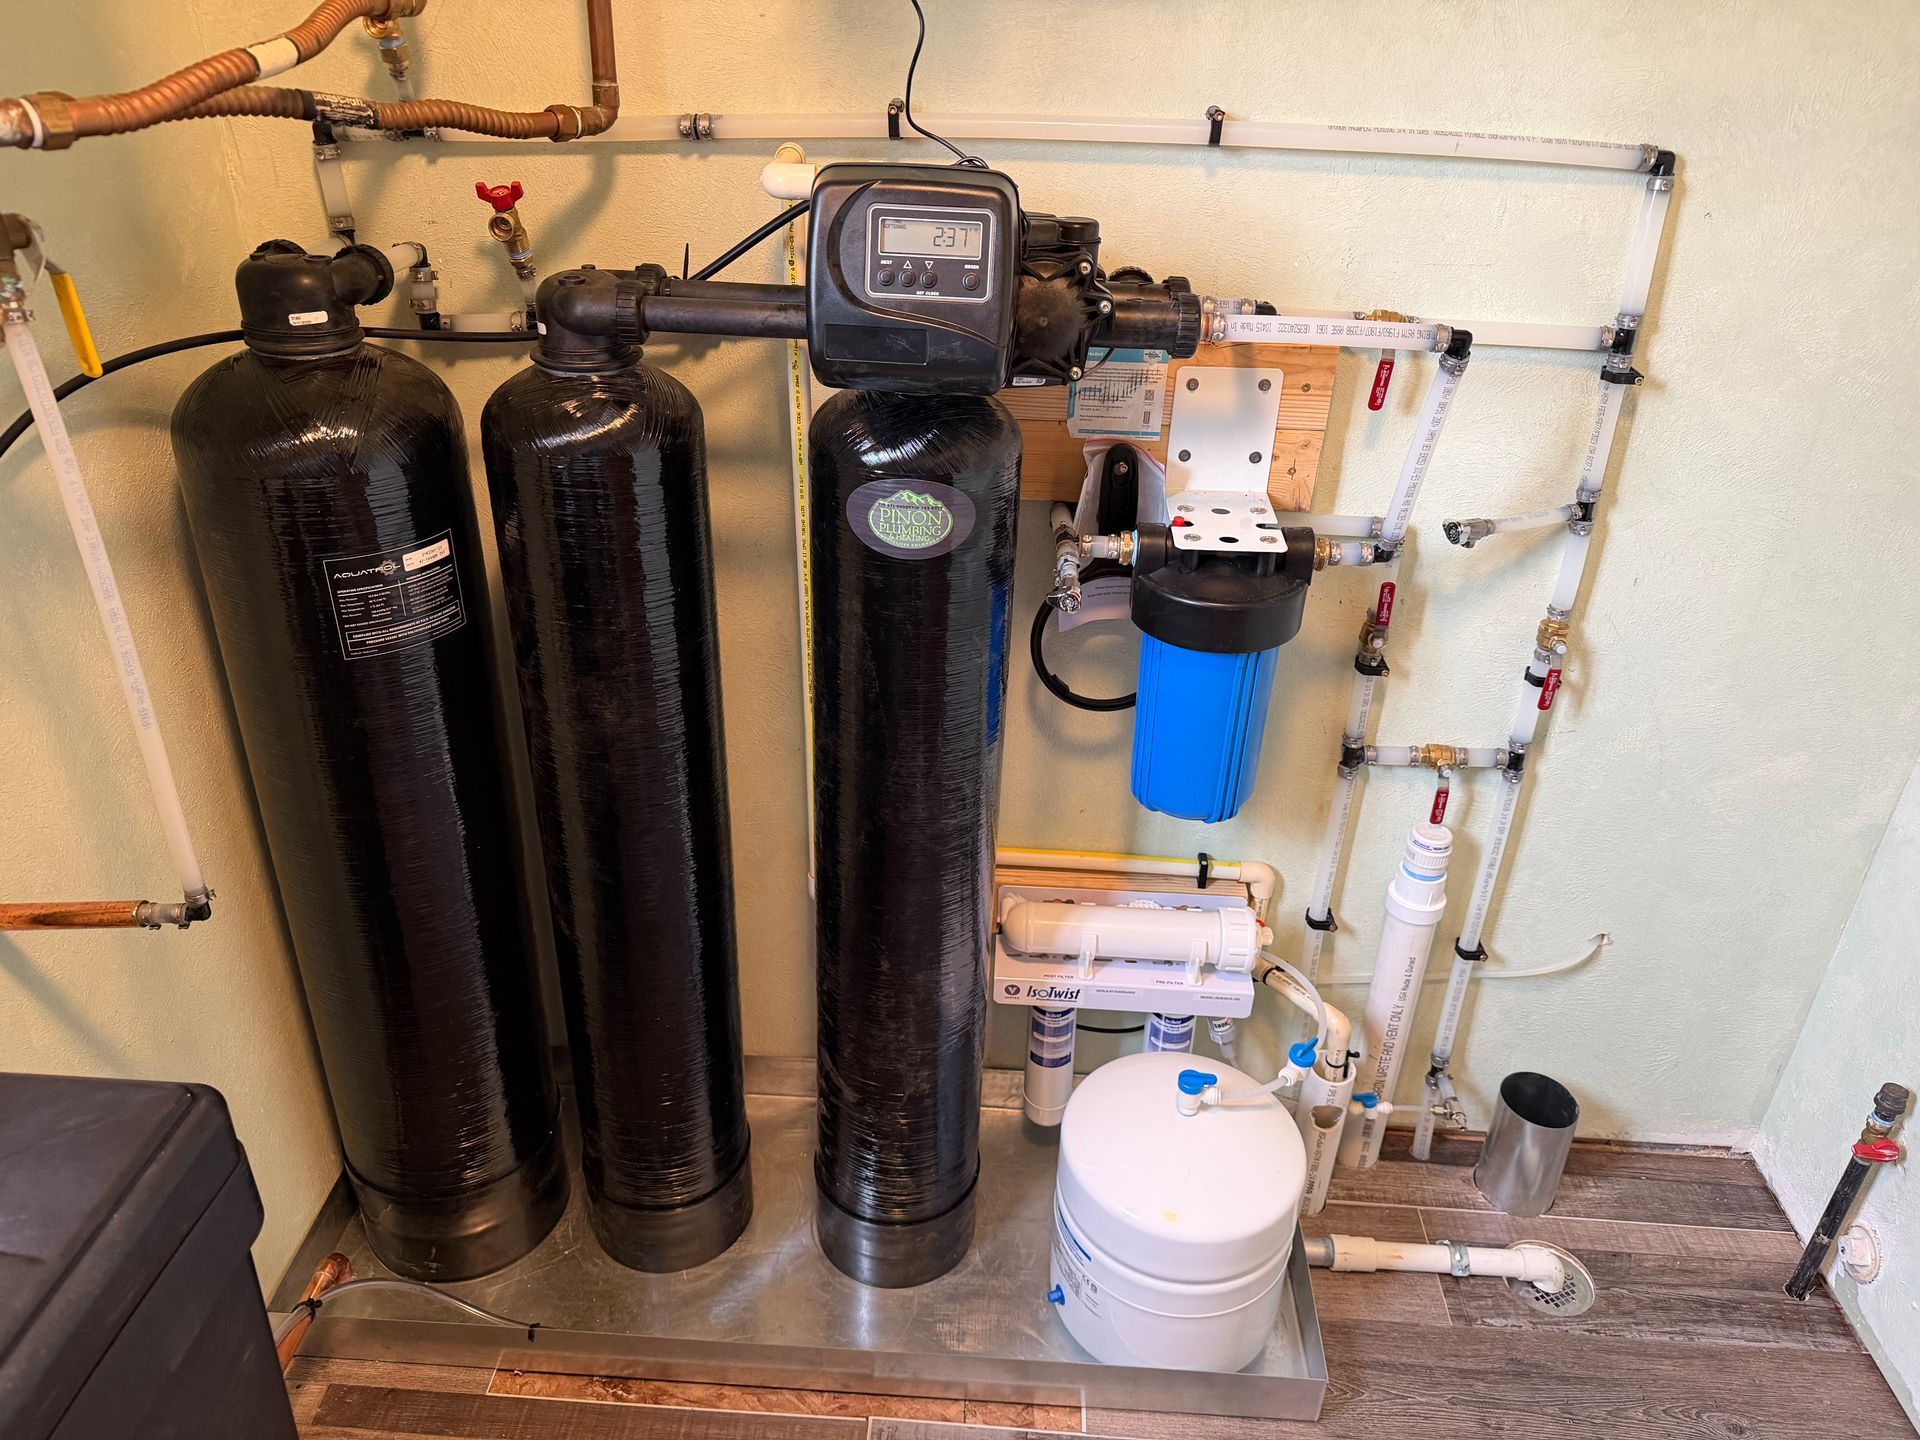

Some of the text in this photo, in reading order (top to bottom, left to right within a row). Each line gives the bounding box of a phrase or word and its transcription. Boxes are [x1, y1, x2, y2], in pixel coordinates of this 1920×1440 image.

[933, 227, 969, 248] 2:37
[1316, 324, 1329, 334] 1061
[1330, 324, 1348, 335] ASSE
[1401, 327, 1415, 339] ASTM
[880, 507, 943, 526] PINON
[879, 522, 941, 536] PLUMBING
[888, 532, 932, 542] & HEATING
[333, 561, 401, 579] AQUATROL
[1026, 985, 1081, 1000] IsoTwist
[1401, 978, 1412, 993] Made
[1393, 1003, 1405, 1024] ONLY
[1386, 1024, 1399, 1042] VENT
[1382, 1041, 1395, 1058] AND
[1376, 1057, 1390, 1078] WASTE
